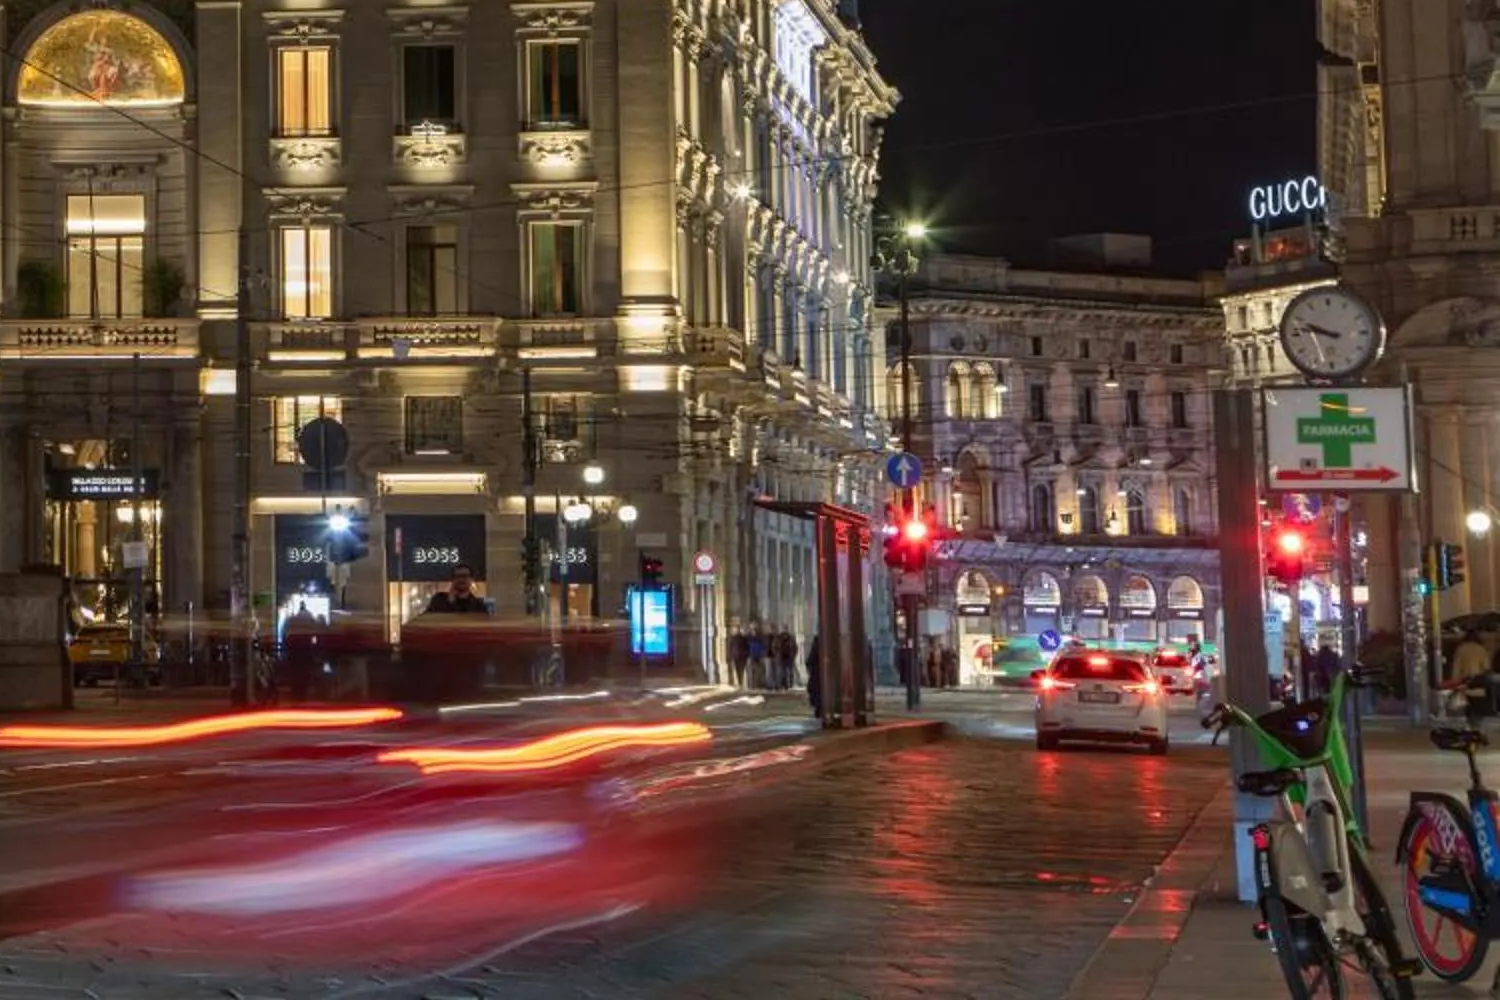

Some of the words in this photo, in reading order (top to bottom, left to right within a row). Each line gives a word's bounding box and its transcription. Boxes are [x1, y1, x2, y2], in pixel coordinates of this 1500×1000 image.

[1302, 424, 1371, 436] FARMACIA
[288, 547, 327, 563] BOS
[414, 547, 460, 563] BOSS
[550, 547, 587, 563] SS
[1474, 811, 1494, 873] dott
